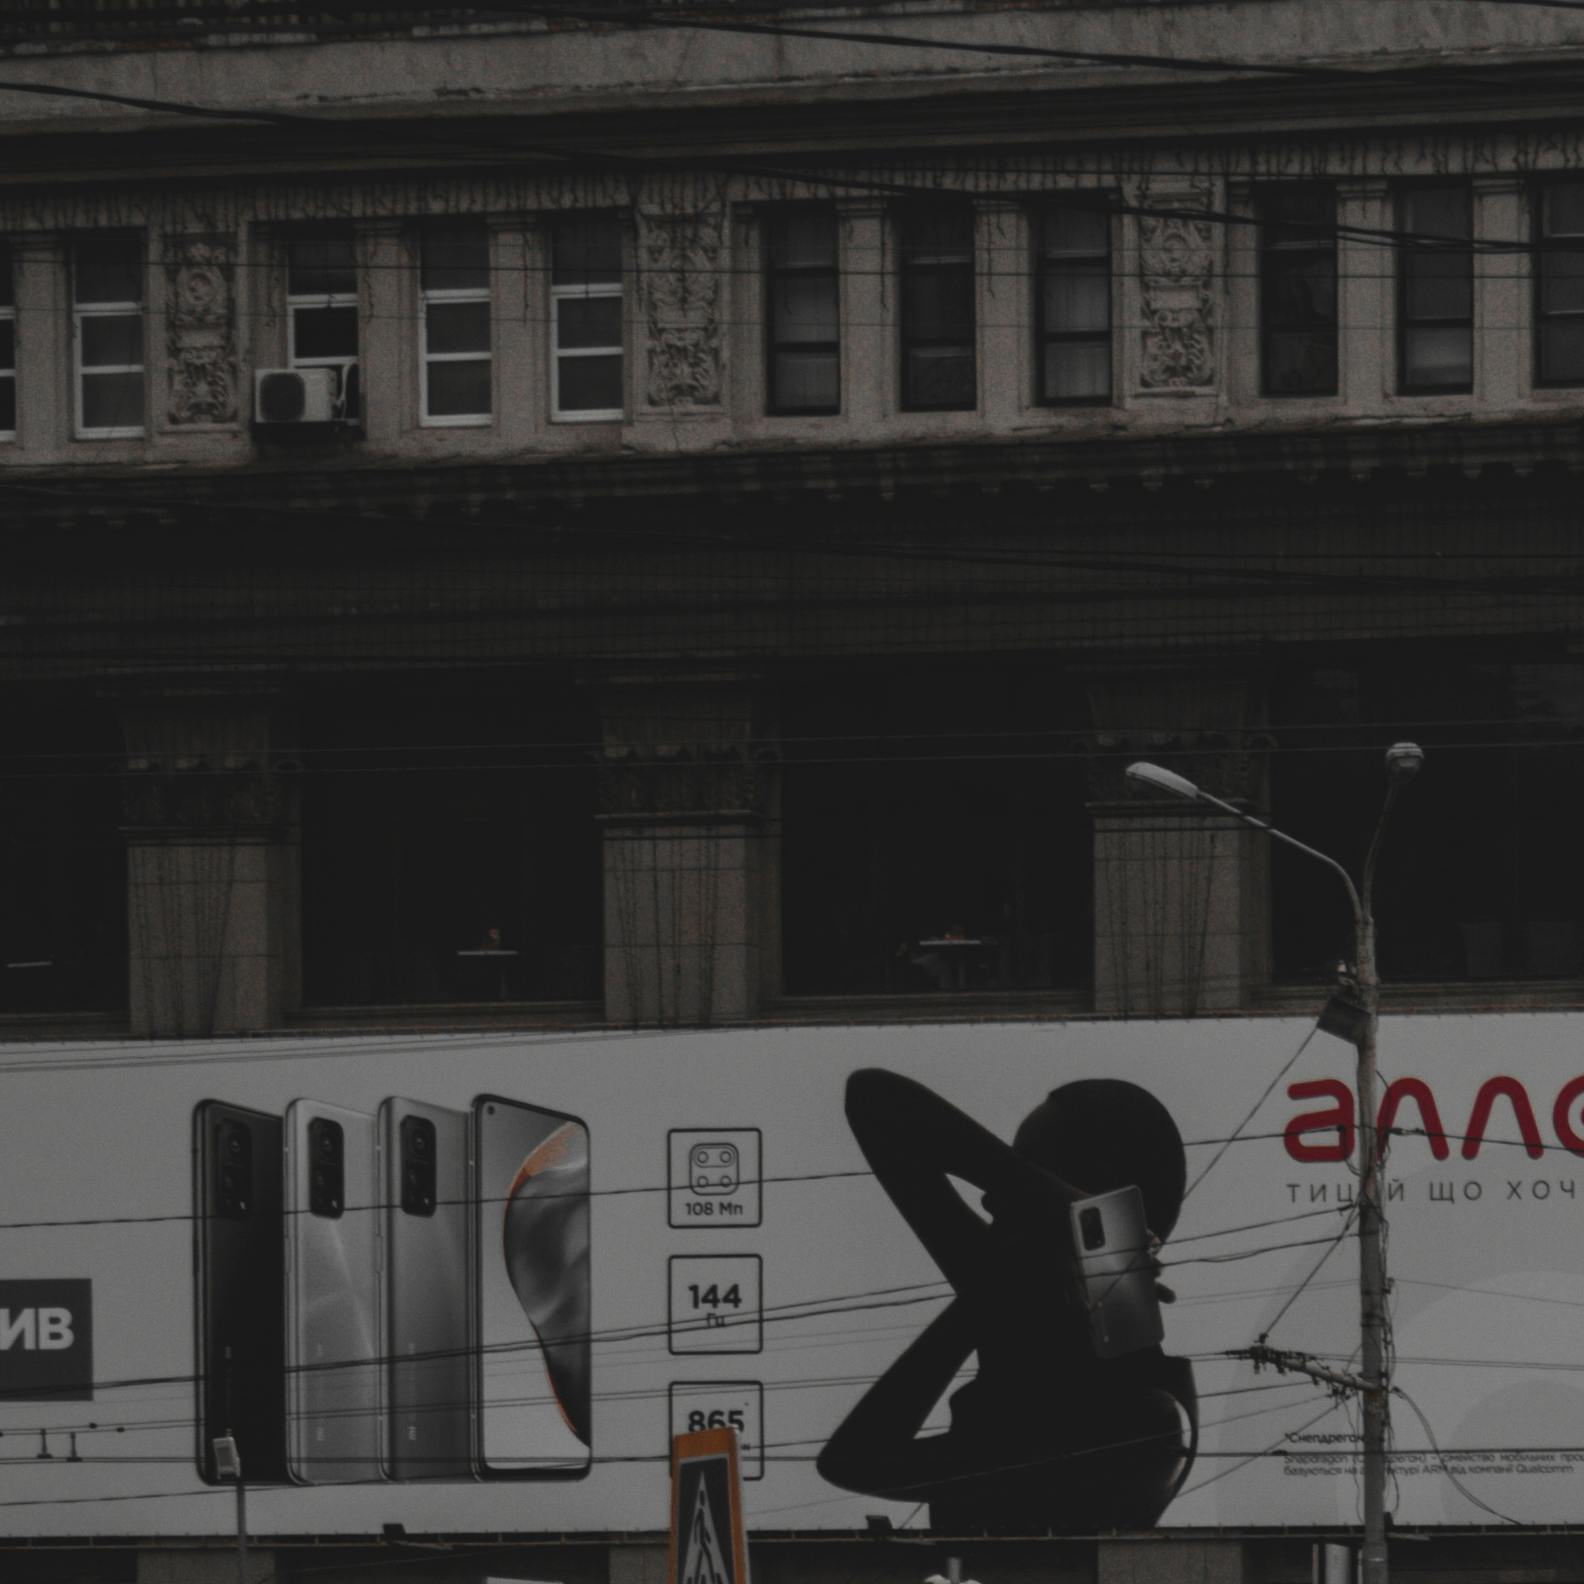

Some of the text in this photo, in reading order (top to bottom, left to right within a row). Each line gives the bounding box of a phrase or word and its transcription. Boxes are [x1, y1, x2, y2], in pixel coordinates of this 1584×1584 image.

[1286, 1179, 1406, 1204] ТИЦЙ
[1429, 1181, 1484, 1204] ЩО
[685, 1202, 713, 1216] 108
[688, 1284, 743, 1310] 144
